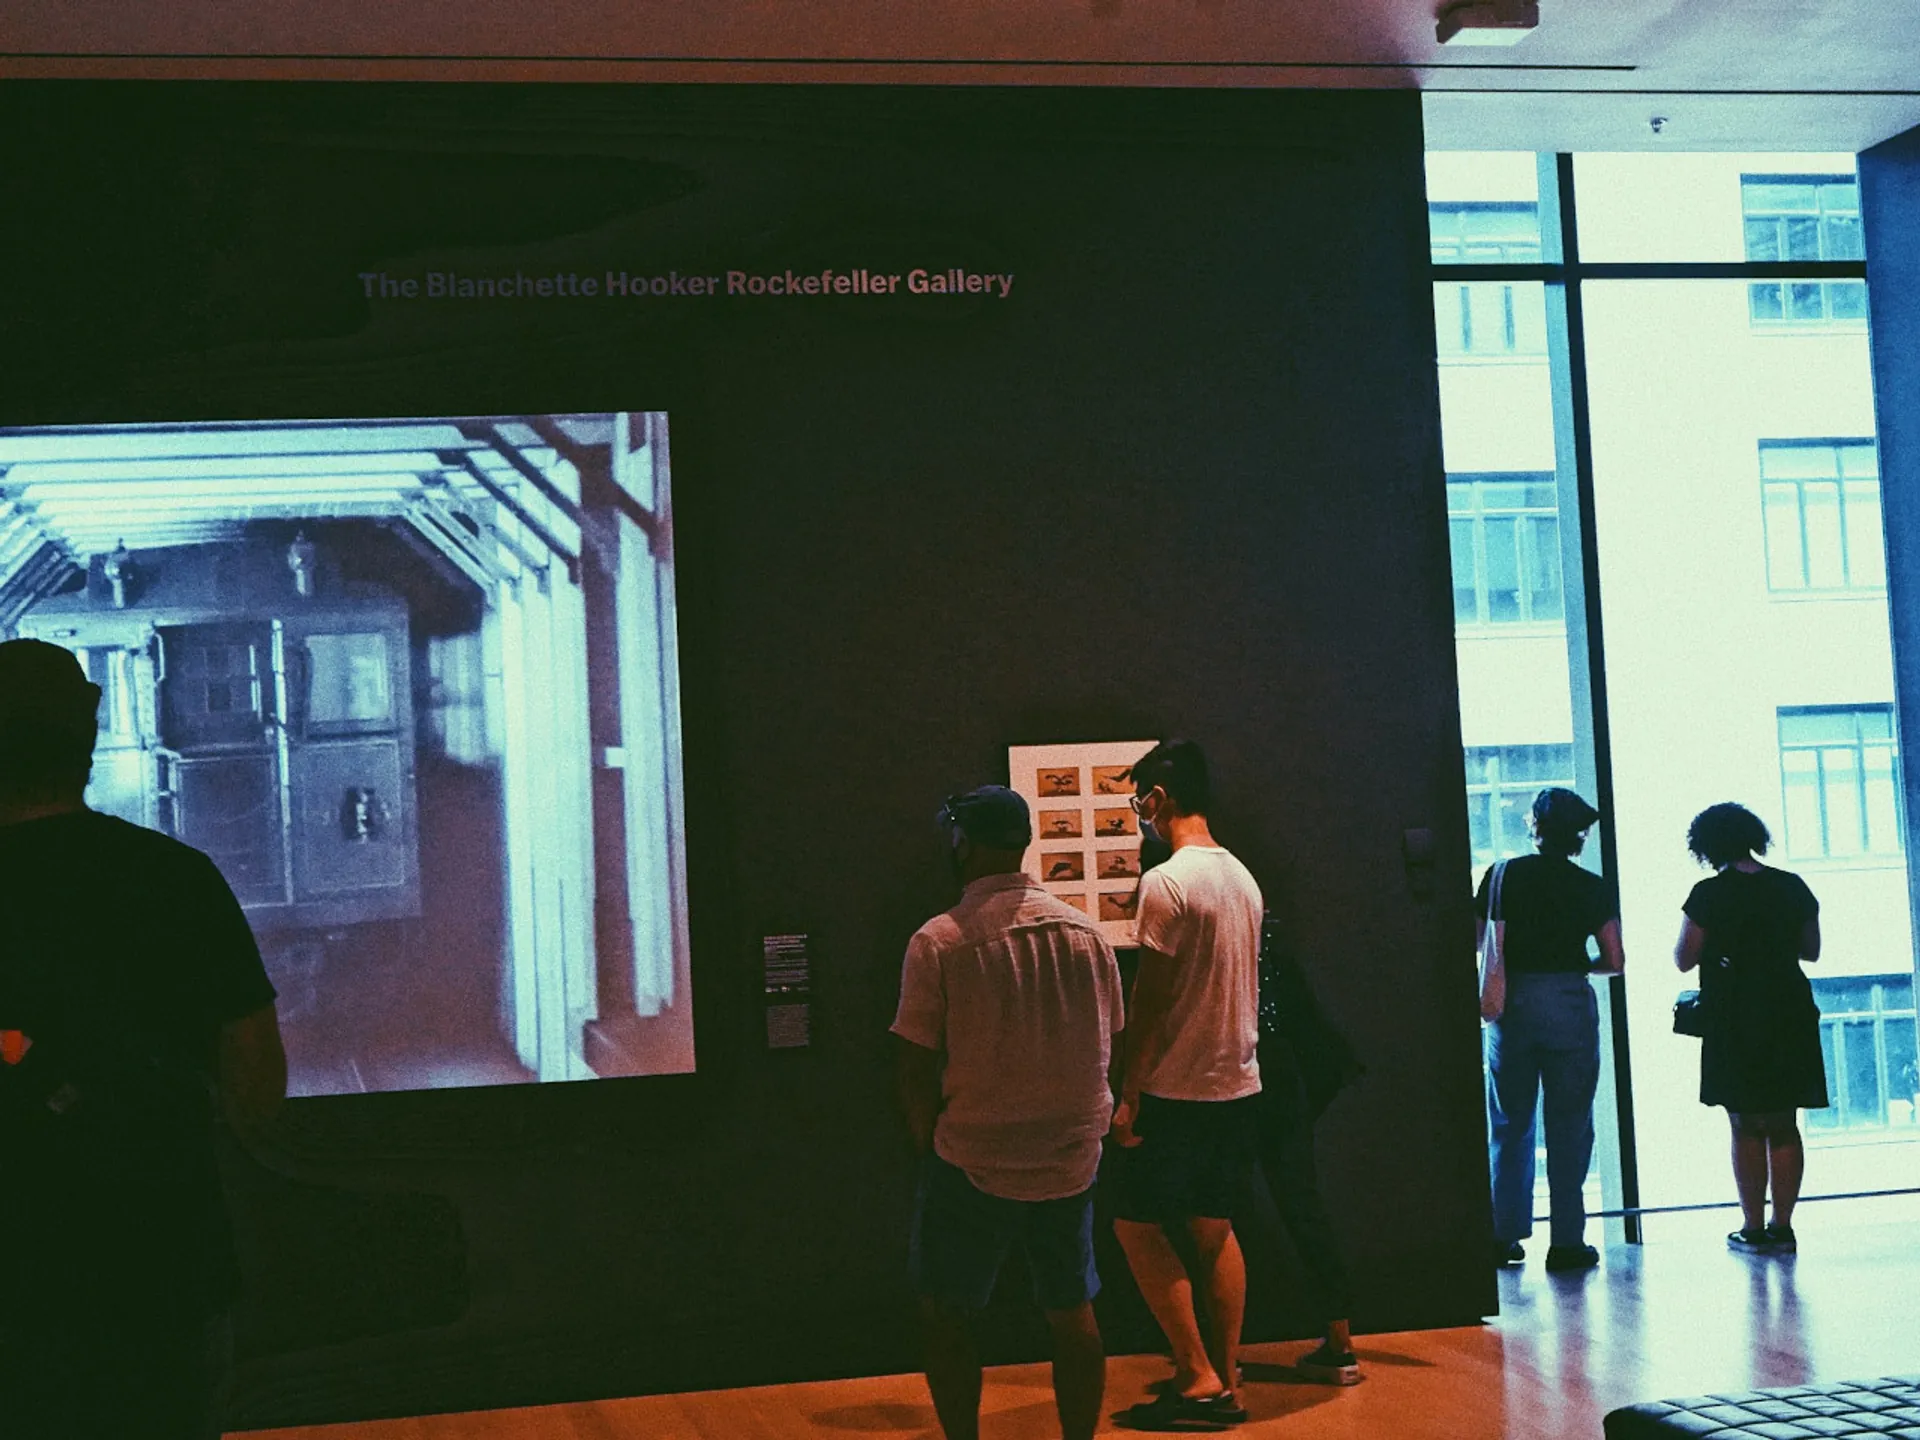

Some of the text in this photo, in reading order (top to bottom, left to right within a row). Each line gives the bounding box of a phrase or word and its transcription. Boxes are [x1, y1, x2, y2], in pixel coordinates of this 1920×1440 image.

[359, 269, 1014, 298] The Blanchette Hooker Rockefeller Gallery
